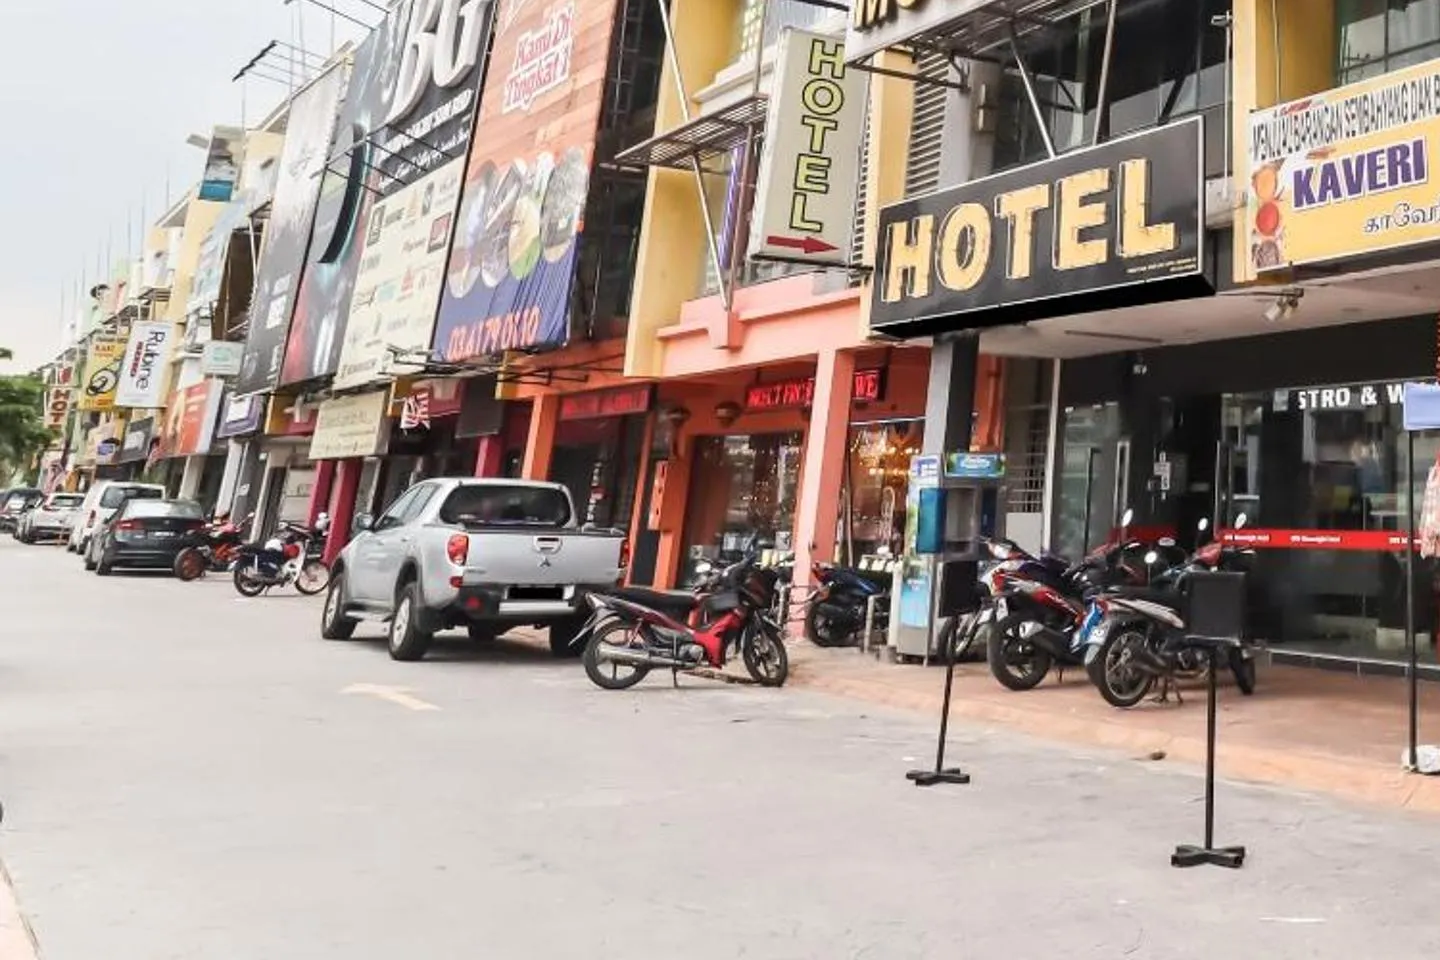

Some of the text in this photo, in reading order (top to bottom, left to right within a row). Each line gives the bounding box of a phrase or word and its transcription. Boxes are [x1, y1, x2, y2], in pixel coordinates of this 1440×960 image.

[1410, 76, 1433, 122] DAN
[790, 39, 846, 233] HOTEL
[1292, 138, 1426, 208] KAVERI
[881, 158, 1178, 303] HOTEL
[1298, 383, 1404, 410] STRO & W
